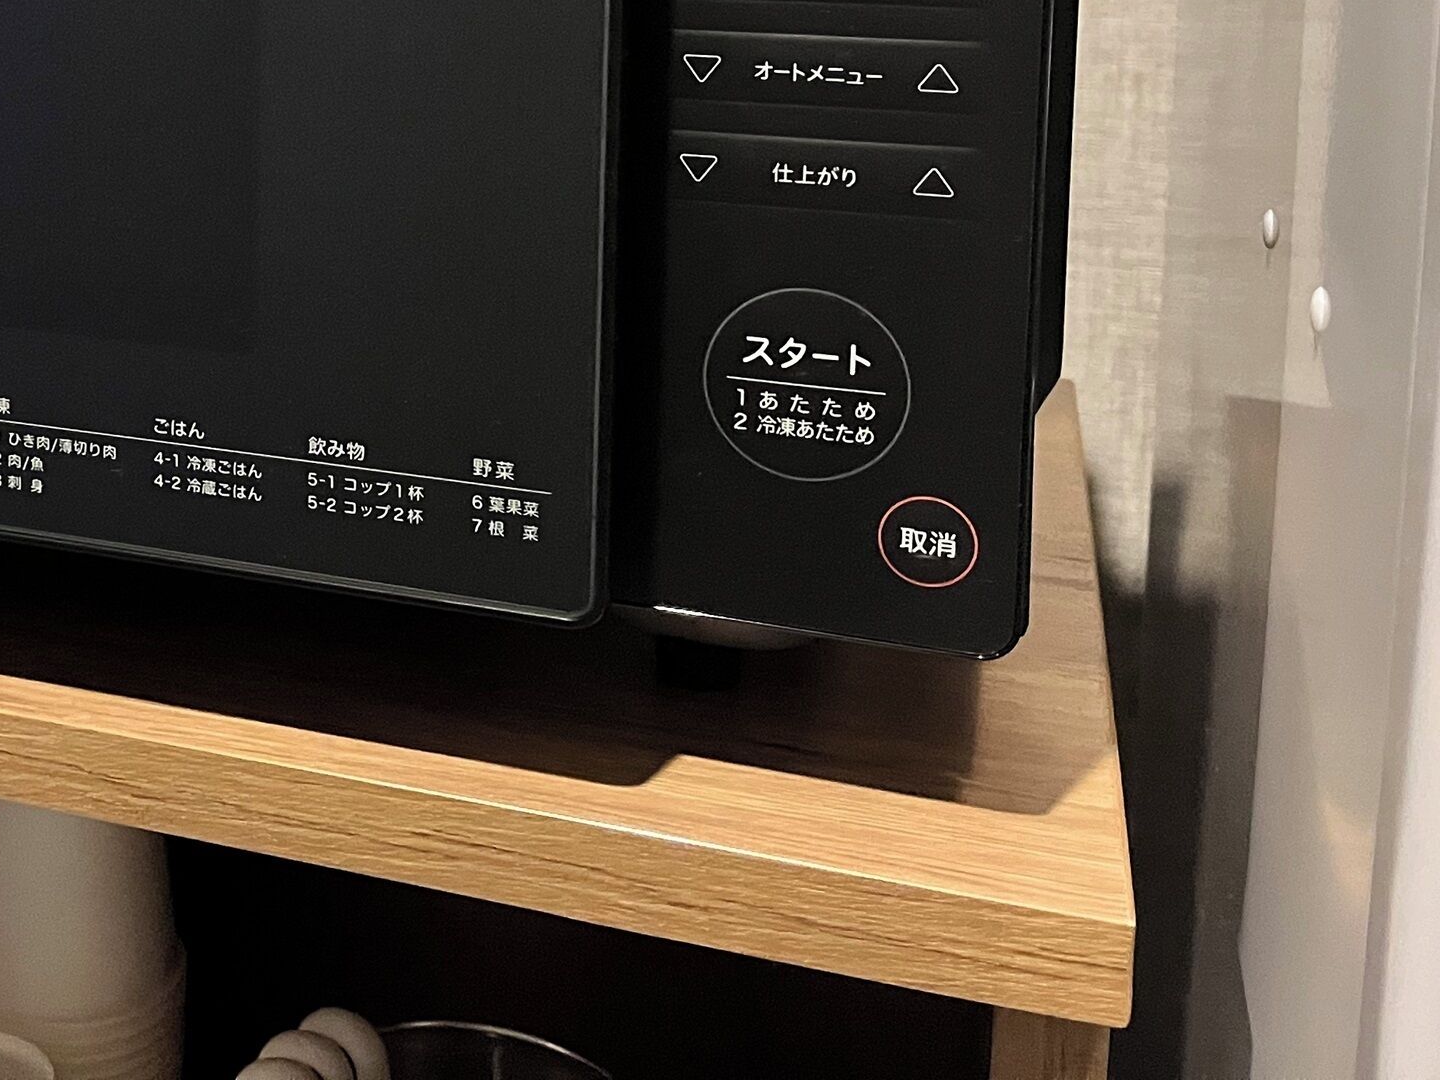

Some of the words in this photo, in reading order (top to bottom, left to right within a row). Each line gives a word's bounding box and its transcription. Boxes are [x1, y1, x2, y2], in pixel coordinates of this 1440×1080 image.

[754, 60, 883, 85] オートメニュー
[771, 162, 857, 188] 仕上がり
[742, 335, 872, 376] スタート
[736, 387, 745, 407] 1
[153, 417, 205, 440] ごはん
[733, 412, 748, 431] 2
[756, 415, 875, 445] 冷凍あたため
[8, 431, 117, 460] ひき肉/薄切り肉
[307, 436, 365, 461] 飲み物
[7, 453, 44, 472] 肉/魚
[153, 451, 179, 468] 4-1
[186, 455, 262, 480] 冷凍ごはん
[472, 457, 515, 481] 野菜
[153, 473, 181, 491] 4-2
[186, 478, 262, 502] 冷蔵ごはん
[307, 472, 334, 489] 5-1
[344, 476, 424, 502] コップ1杯
[307, 495, 337, 513] 5-2
[344, 500, 424, 525] コップ2杯
[471, 494, 483, 510] 6
[488, 495, 540, 518] 葉果菜
[471, 518, 483, 533] 7
[899, 526, 957, 559] 取消
